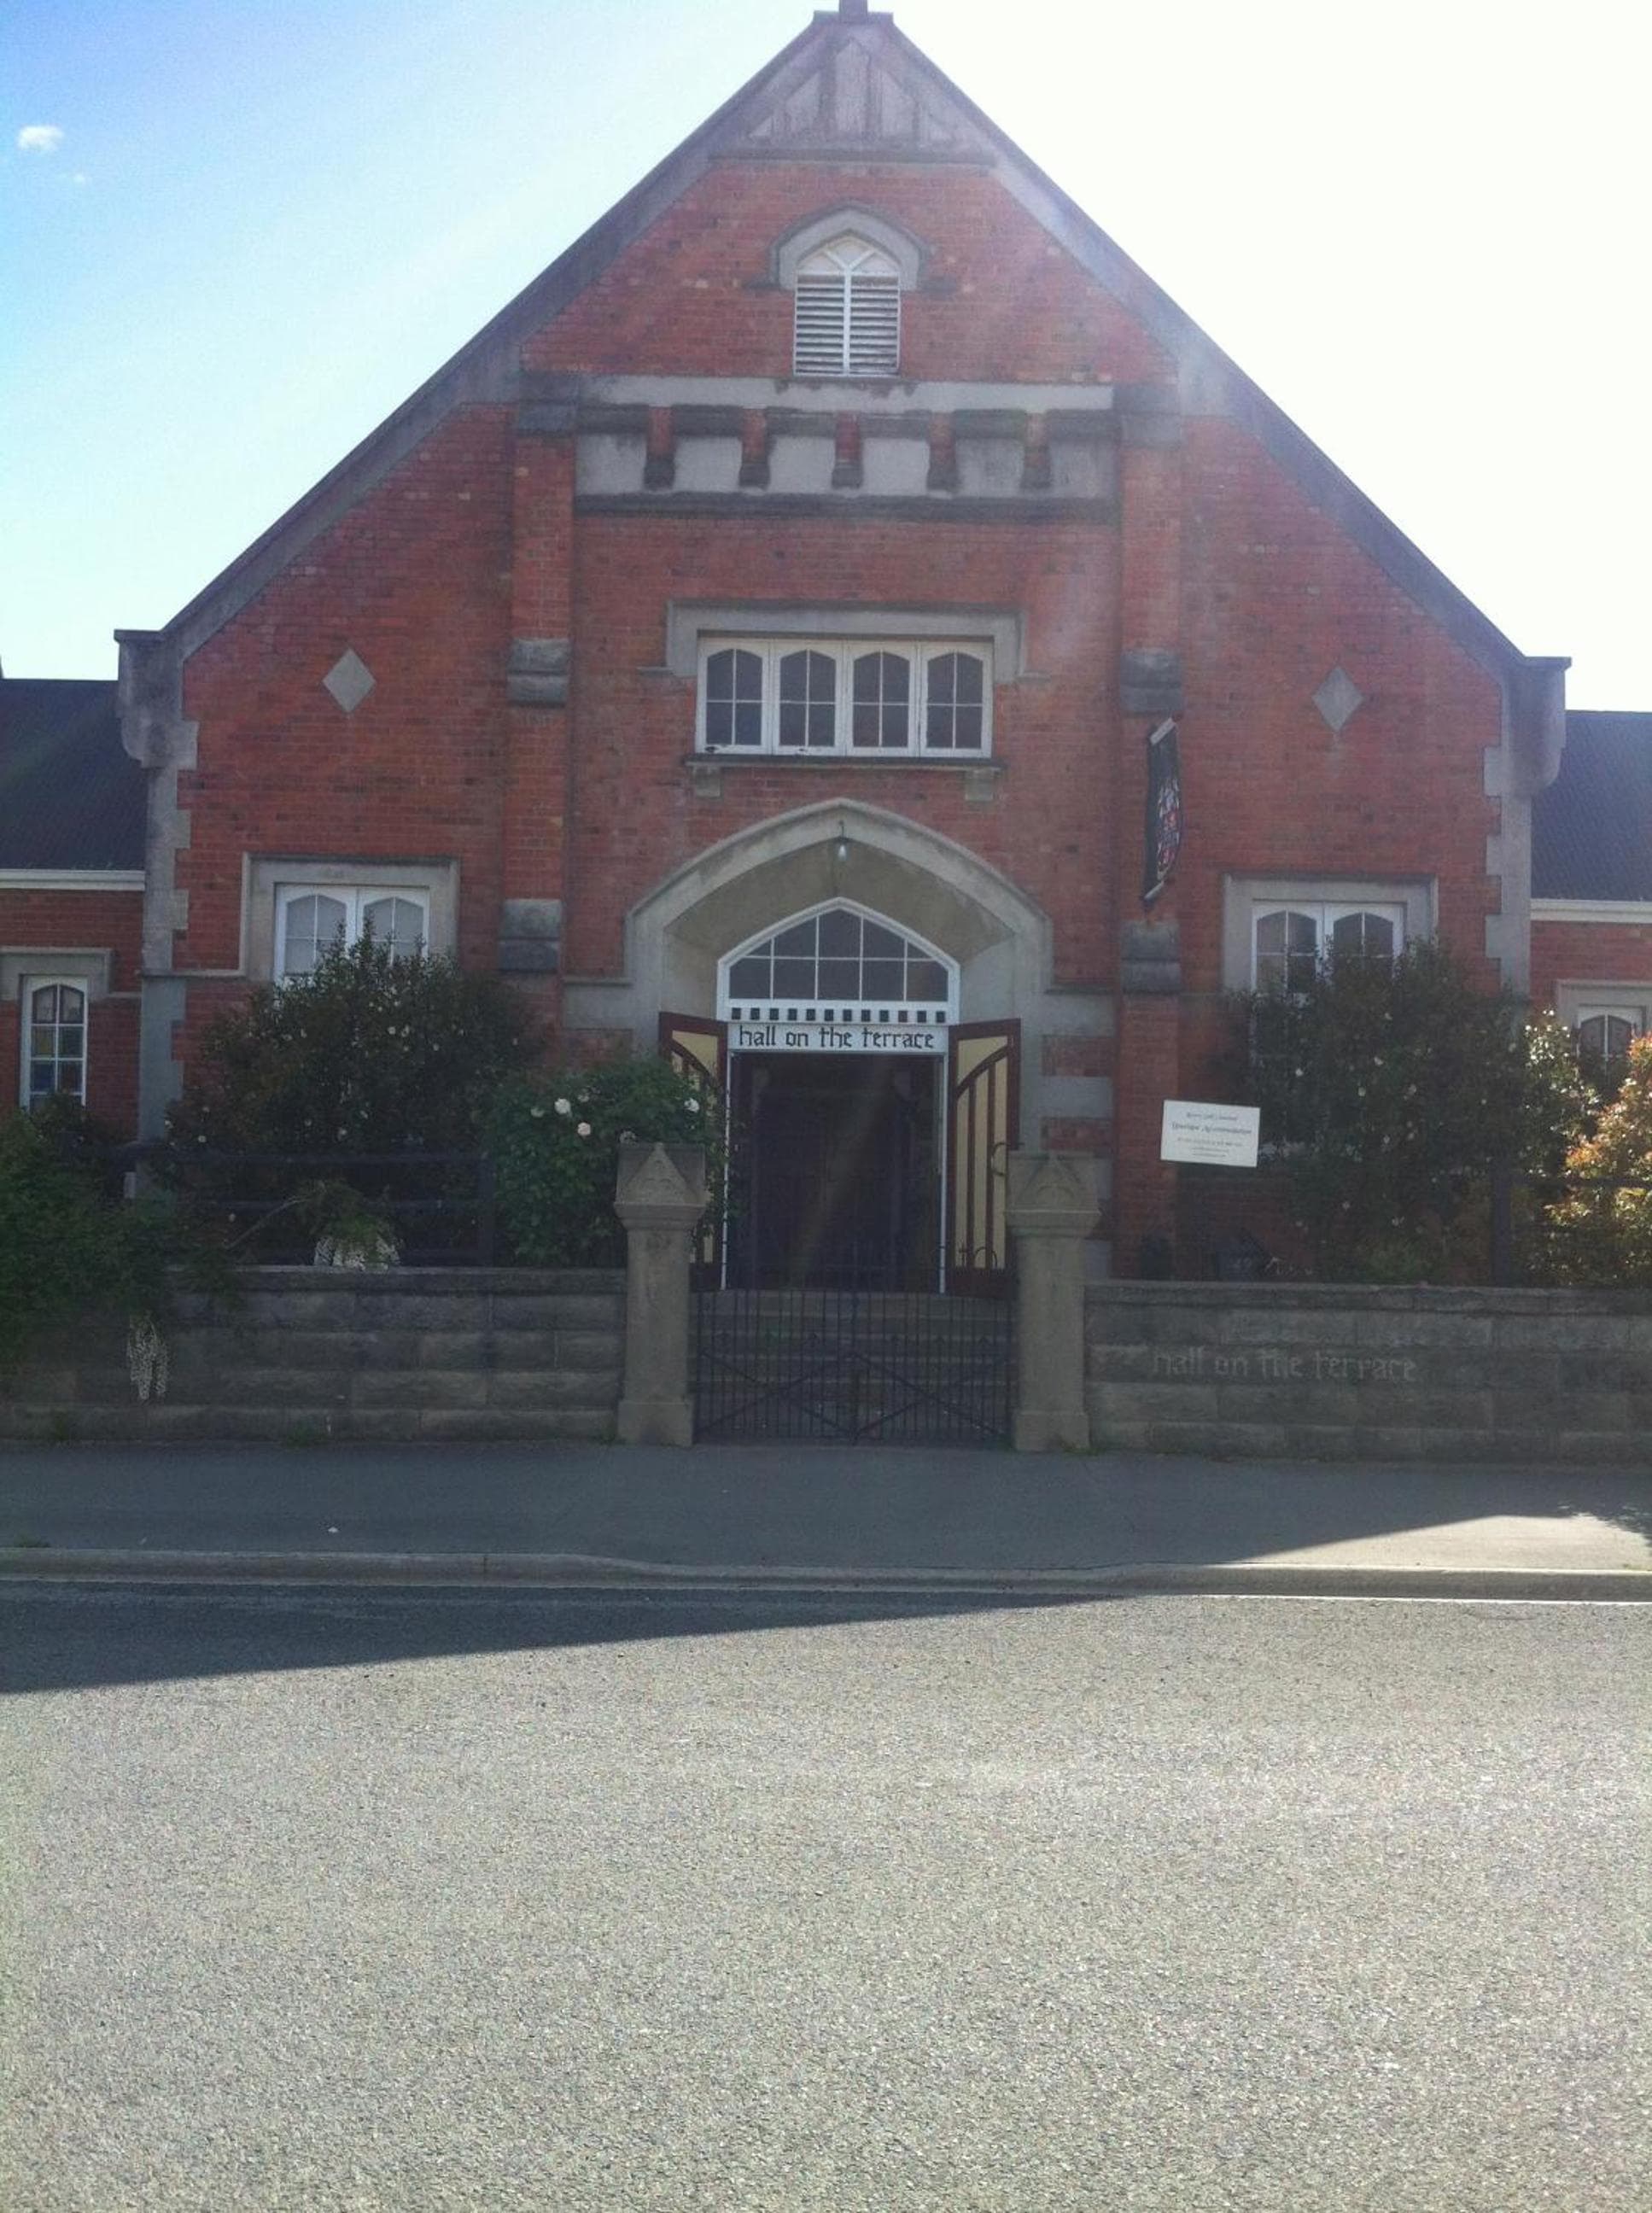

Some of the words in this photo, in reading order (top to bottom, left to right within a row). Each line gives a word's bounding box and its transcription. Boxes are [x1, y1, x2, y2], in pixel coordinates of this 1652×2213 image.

[739, 1025, 776, 1047] hall
[785, 1033, 809, 1047] on
[819, 1025, 853, 1048] the
[861, 1026, 934, 1048] terrace
[1215, 1357, 1247, 1377] on
[1316, 1350, 1417, 1381] terrace
